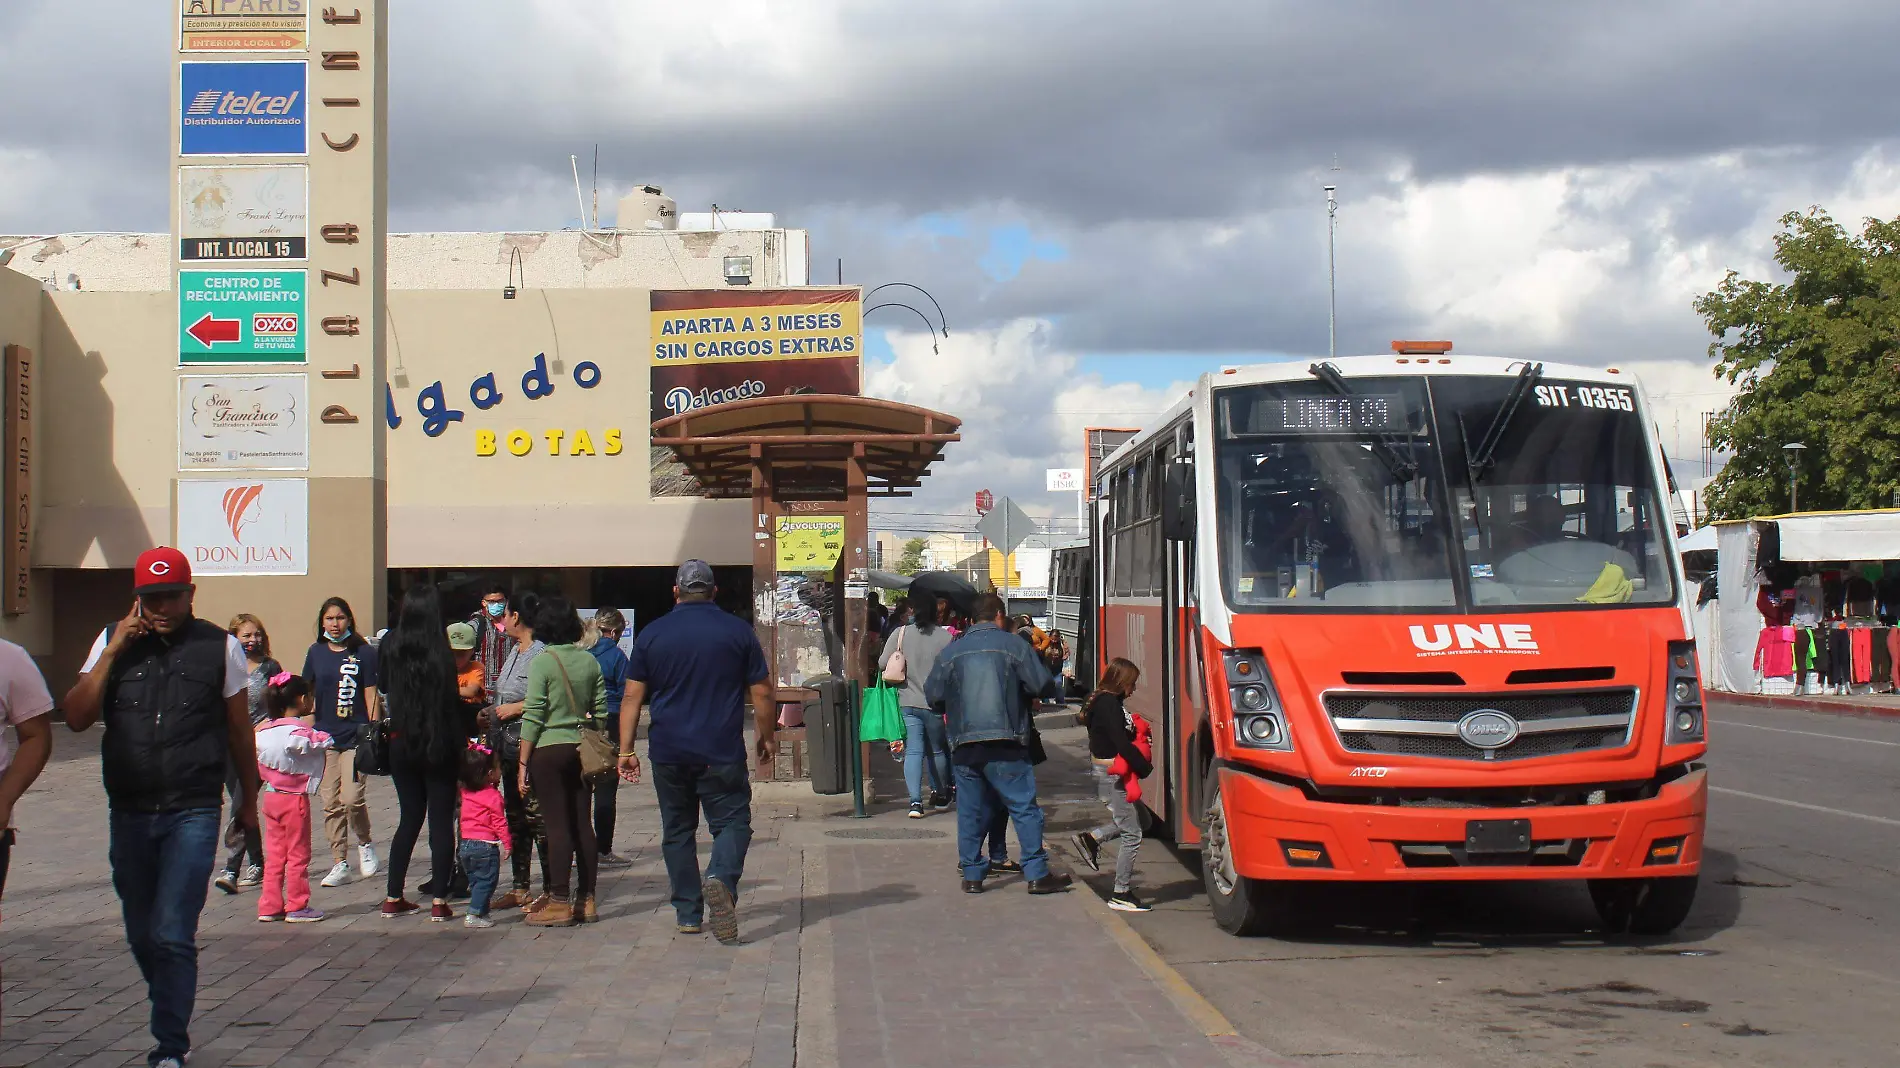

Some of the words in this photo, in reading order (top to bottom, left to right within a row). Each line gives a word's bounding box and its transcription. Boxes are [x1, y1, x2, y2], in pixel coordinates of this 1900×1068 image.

[220, 0, 301, 12] PARIS
[193, 39, 241, 47] INTERIOR
[244, 39, 277, 47] LOCAL
[280, 39, 291, 47] 18
[217, 91, 299, 116] telcel
[184, 117, 244, 126] Distribuidor
[246, 117, 301, 126] Autorizado
[237, 208, 272, 221] Frank
[274, 207, 306, 223] Leyva
[198, 241, 224, 258] INT.
[228, 240, 272, 258] LOCAL
[274, 240, 291, 257] 15
[204, 277, 260, 289] CENTRO
[263, 277, 282, 288] DE
[186, 290, 300, 302] RECLUTAMIENTO
[255, 317, 297, 333] OXXO
[321, 223, 360, 424] PLAZA
[661, 317, 736, 336] APARTA
[741, 317, 755, 332] A
[760, 315, 772, 332] 3
[777, 313, 842, 331] MESES
[655, 343, 688, 360] SIN
[694, 339, 774, 358] CARGOS
[779, 336, 855, 354] EXTRAS
[206, 394, 230, 407] San
[1534, 385, 1634, 412] SIT-0355
[212, 406, 279, 422] Francisco
[1283, 399, 1352, 428] LINEA
[1361, 398, 1388, 427] 09
[475, 428, 623, 457] BOTAS
[1053, 480, 1078, 488] HSBC
[194, 546, 239, 562] DON
[245, 546, 292, 564] JUAN
[149, 560, 170, 576] C
[1408, 623, 1539, 651] UNE
[336, 663, 359, 718] 04015
